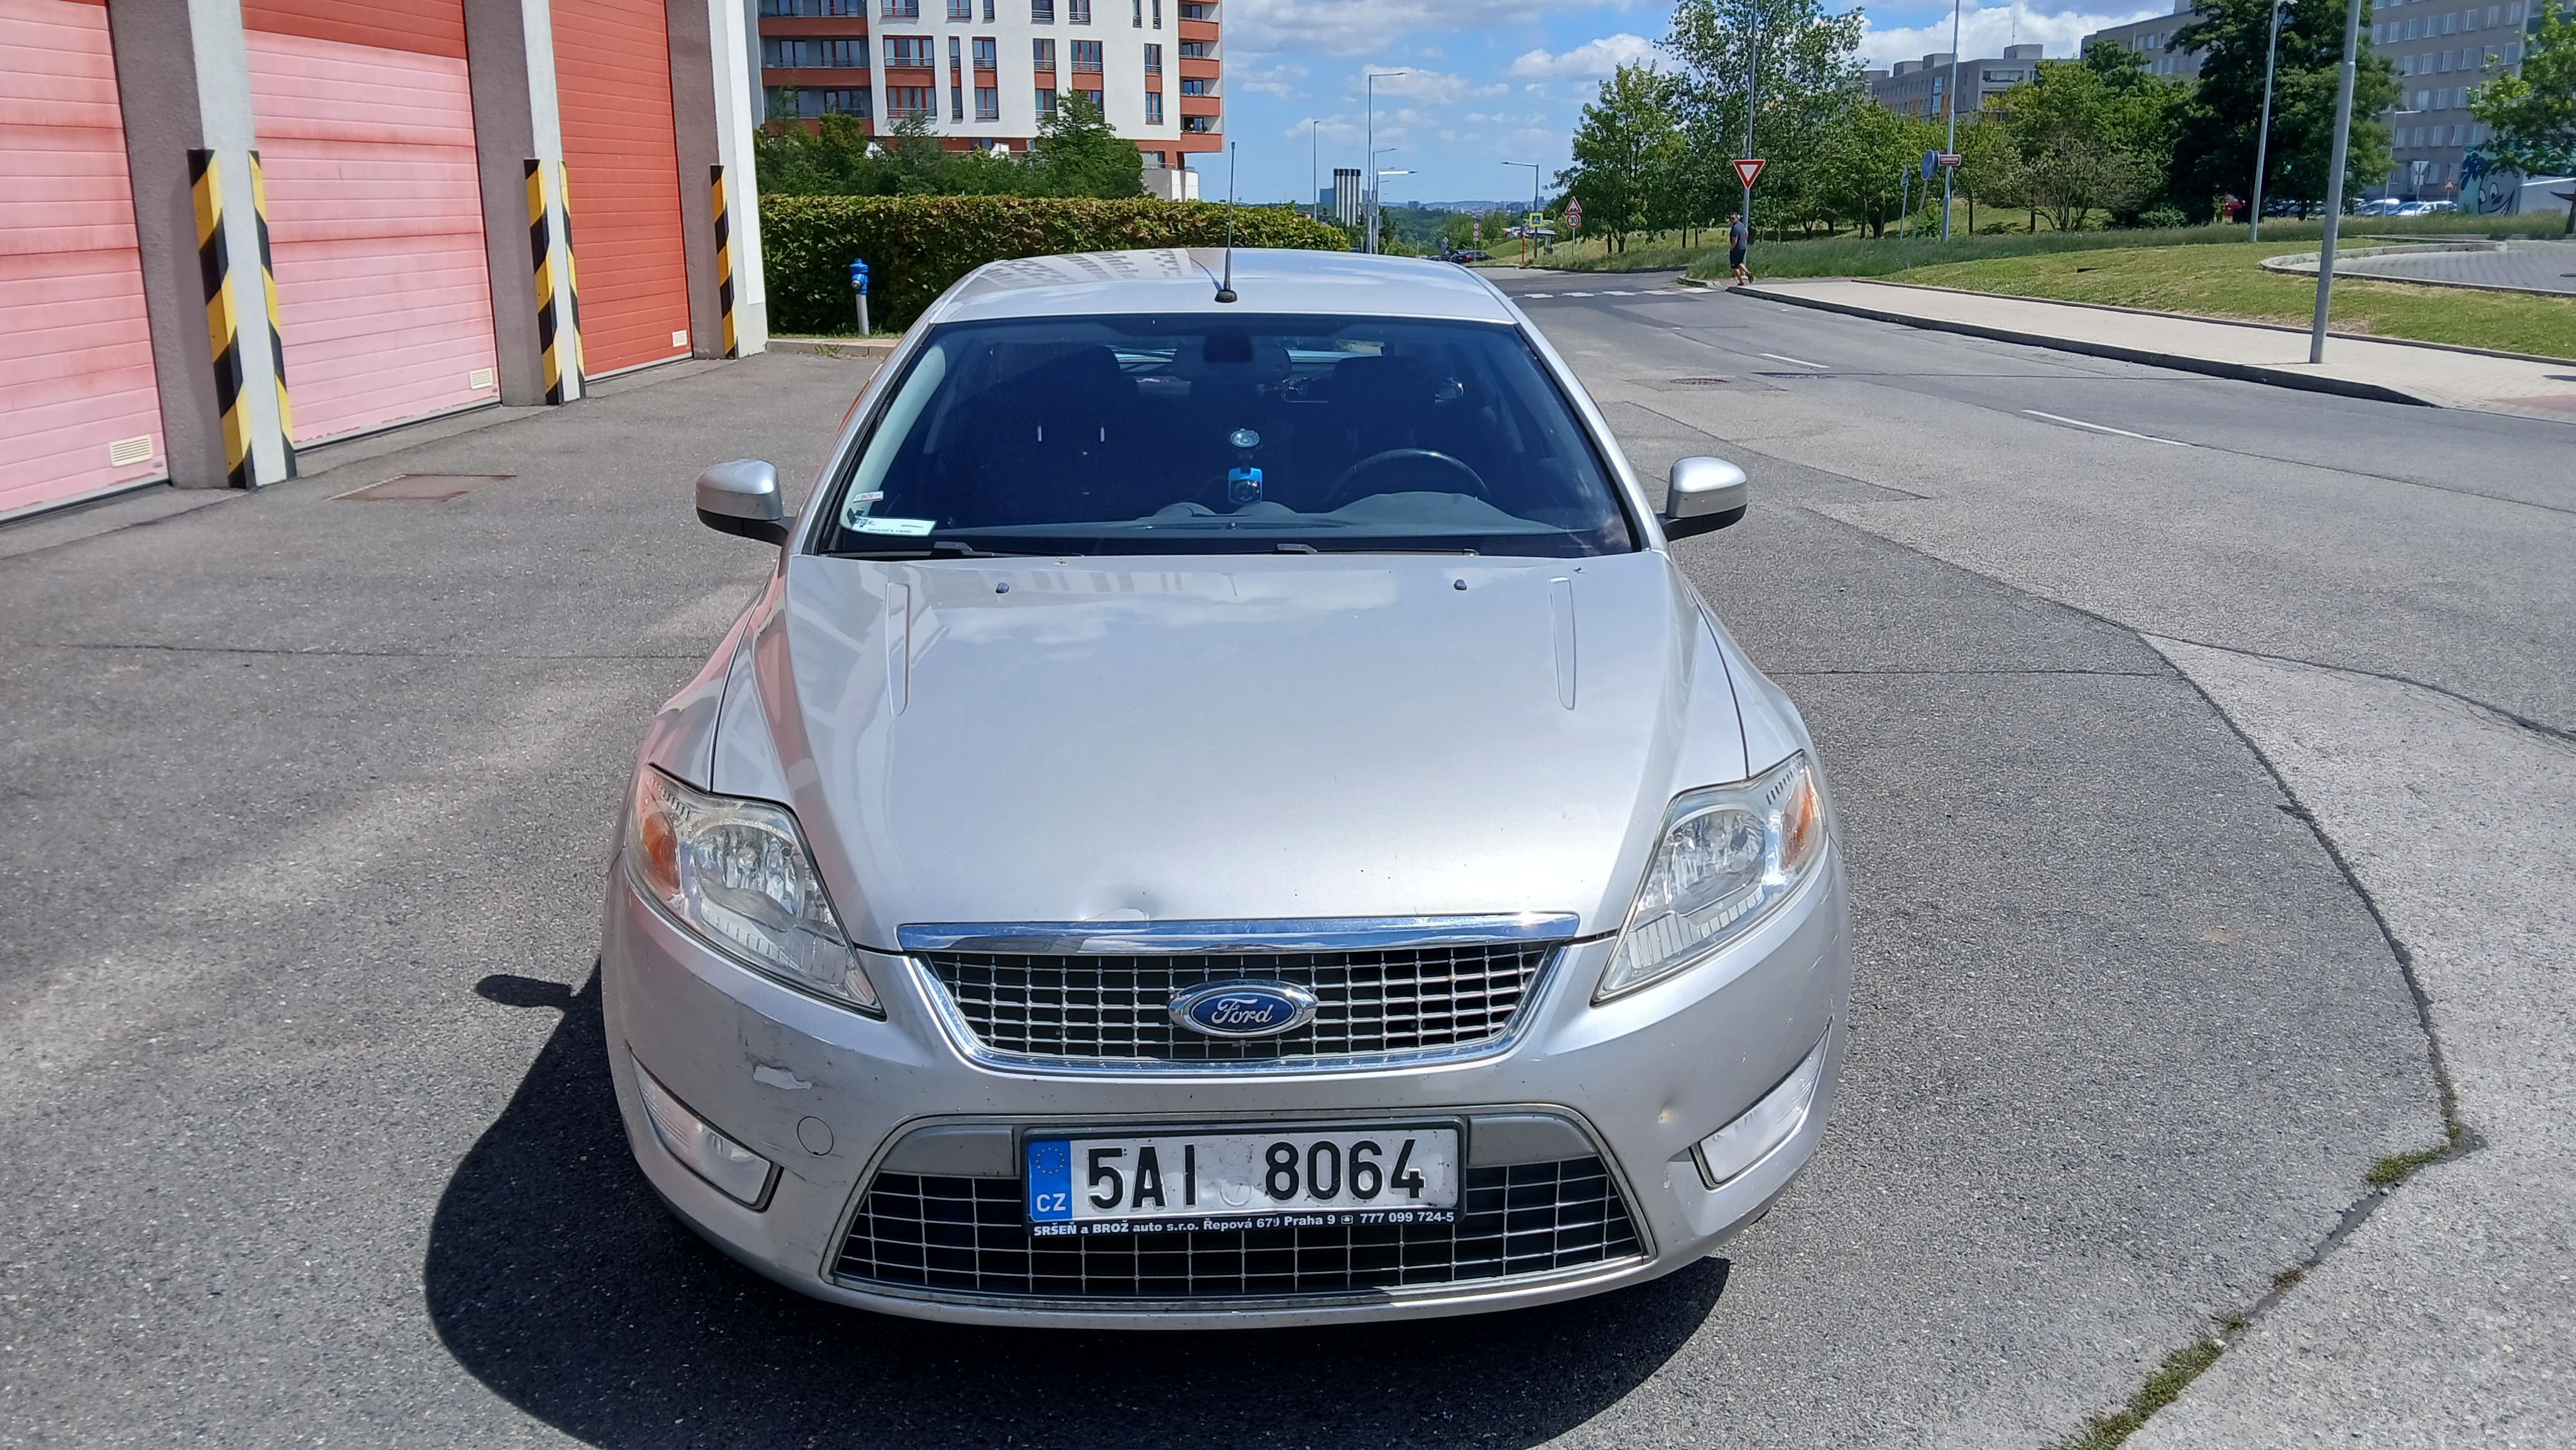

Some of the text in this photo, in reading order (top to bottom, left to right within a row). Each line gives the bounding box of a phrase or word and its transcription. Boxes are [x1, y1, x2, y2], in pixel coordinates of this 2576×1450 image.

[1211, 998, 1273, 1024] Ford
[1087, 1139, 1426, 1210] 5AI 8064
[1036, 1194, 1066, 1213] CZ
[1034, 1211, 1454, 1236] SRŠEŇ a BROŽ auto s.r.o. Řepová 679 Praha 9 777 099 724-5
